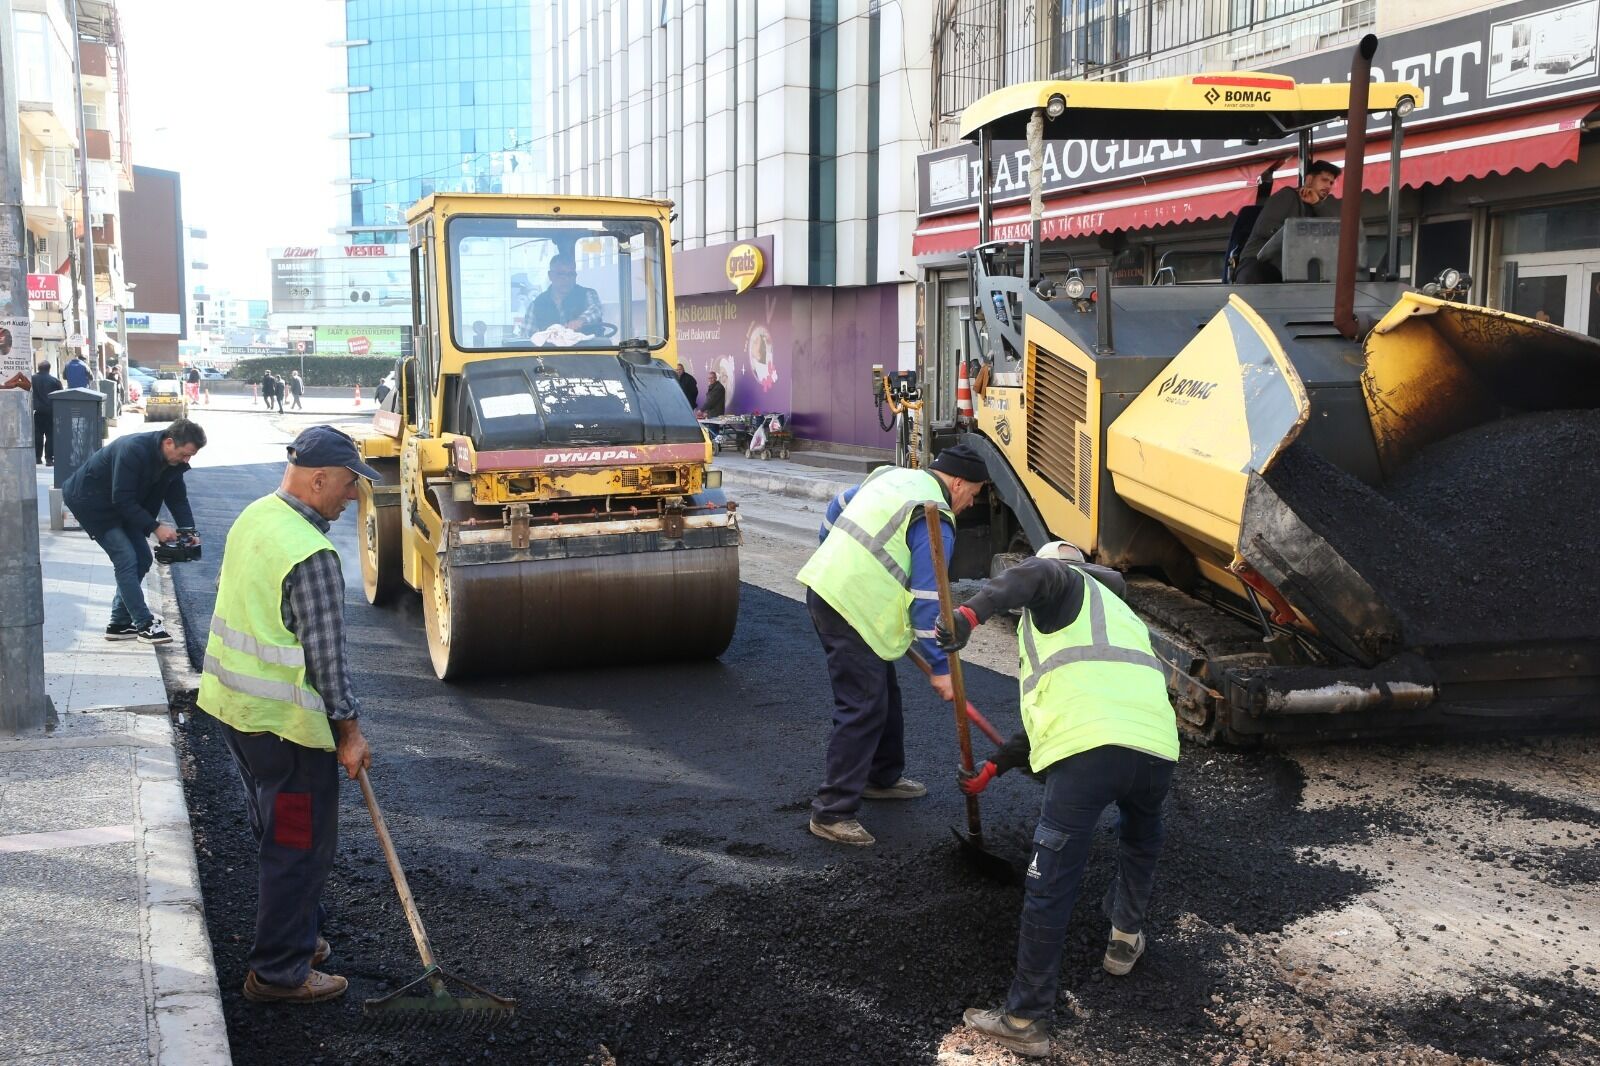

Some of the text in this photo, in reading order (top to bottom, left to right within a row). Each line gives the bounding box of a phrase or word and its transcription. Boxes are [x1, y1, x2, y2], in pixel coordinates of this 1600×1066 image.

[1225, 91, 1271, 102] BOMAG
[283, 246, 319, 257] arzum
[344, 246, 388, 256] VESTEL
[730, 249, 755, 278] gratis
[37, 276, 46, 289] 7.
[28, 289, 57, 299] NOTER
[691, 303, 723, 326] Beauty
[724, 299, 737, 320] ile
[1172, 378, 1218, 400] BOMAG
